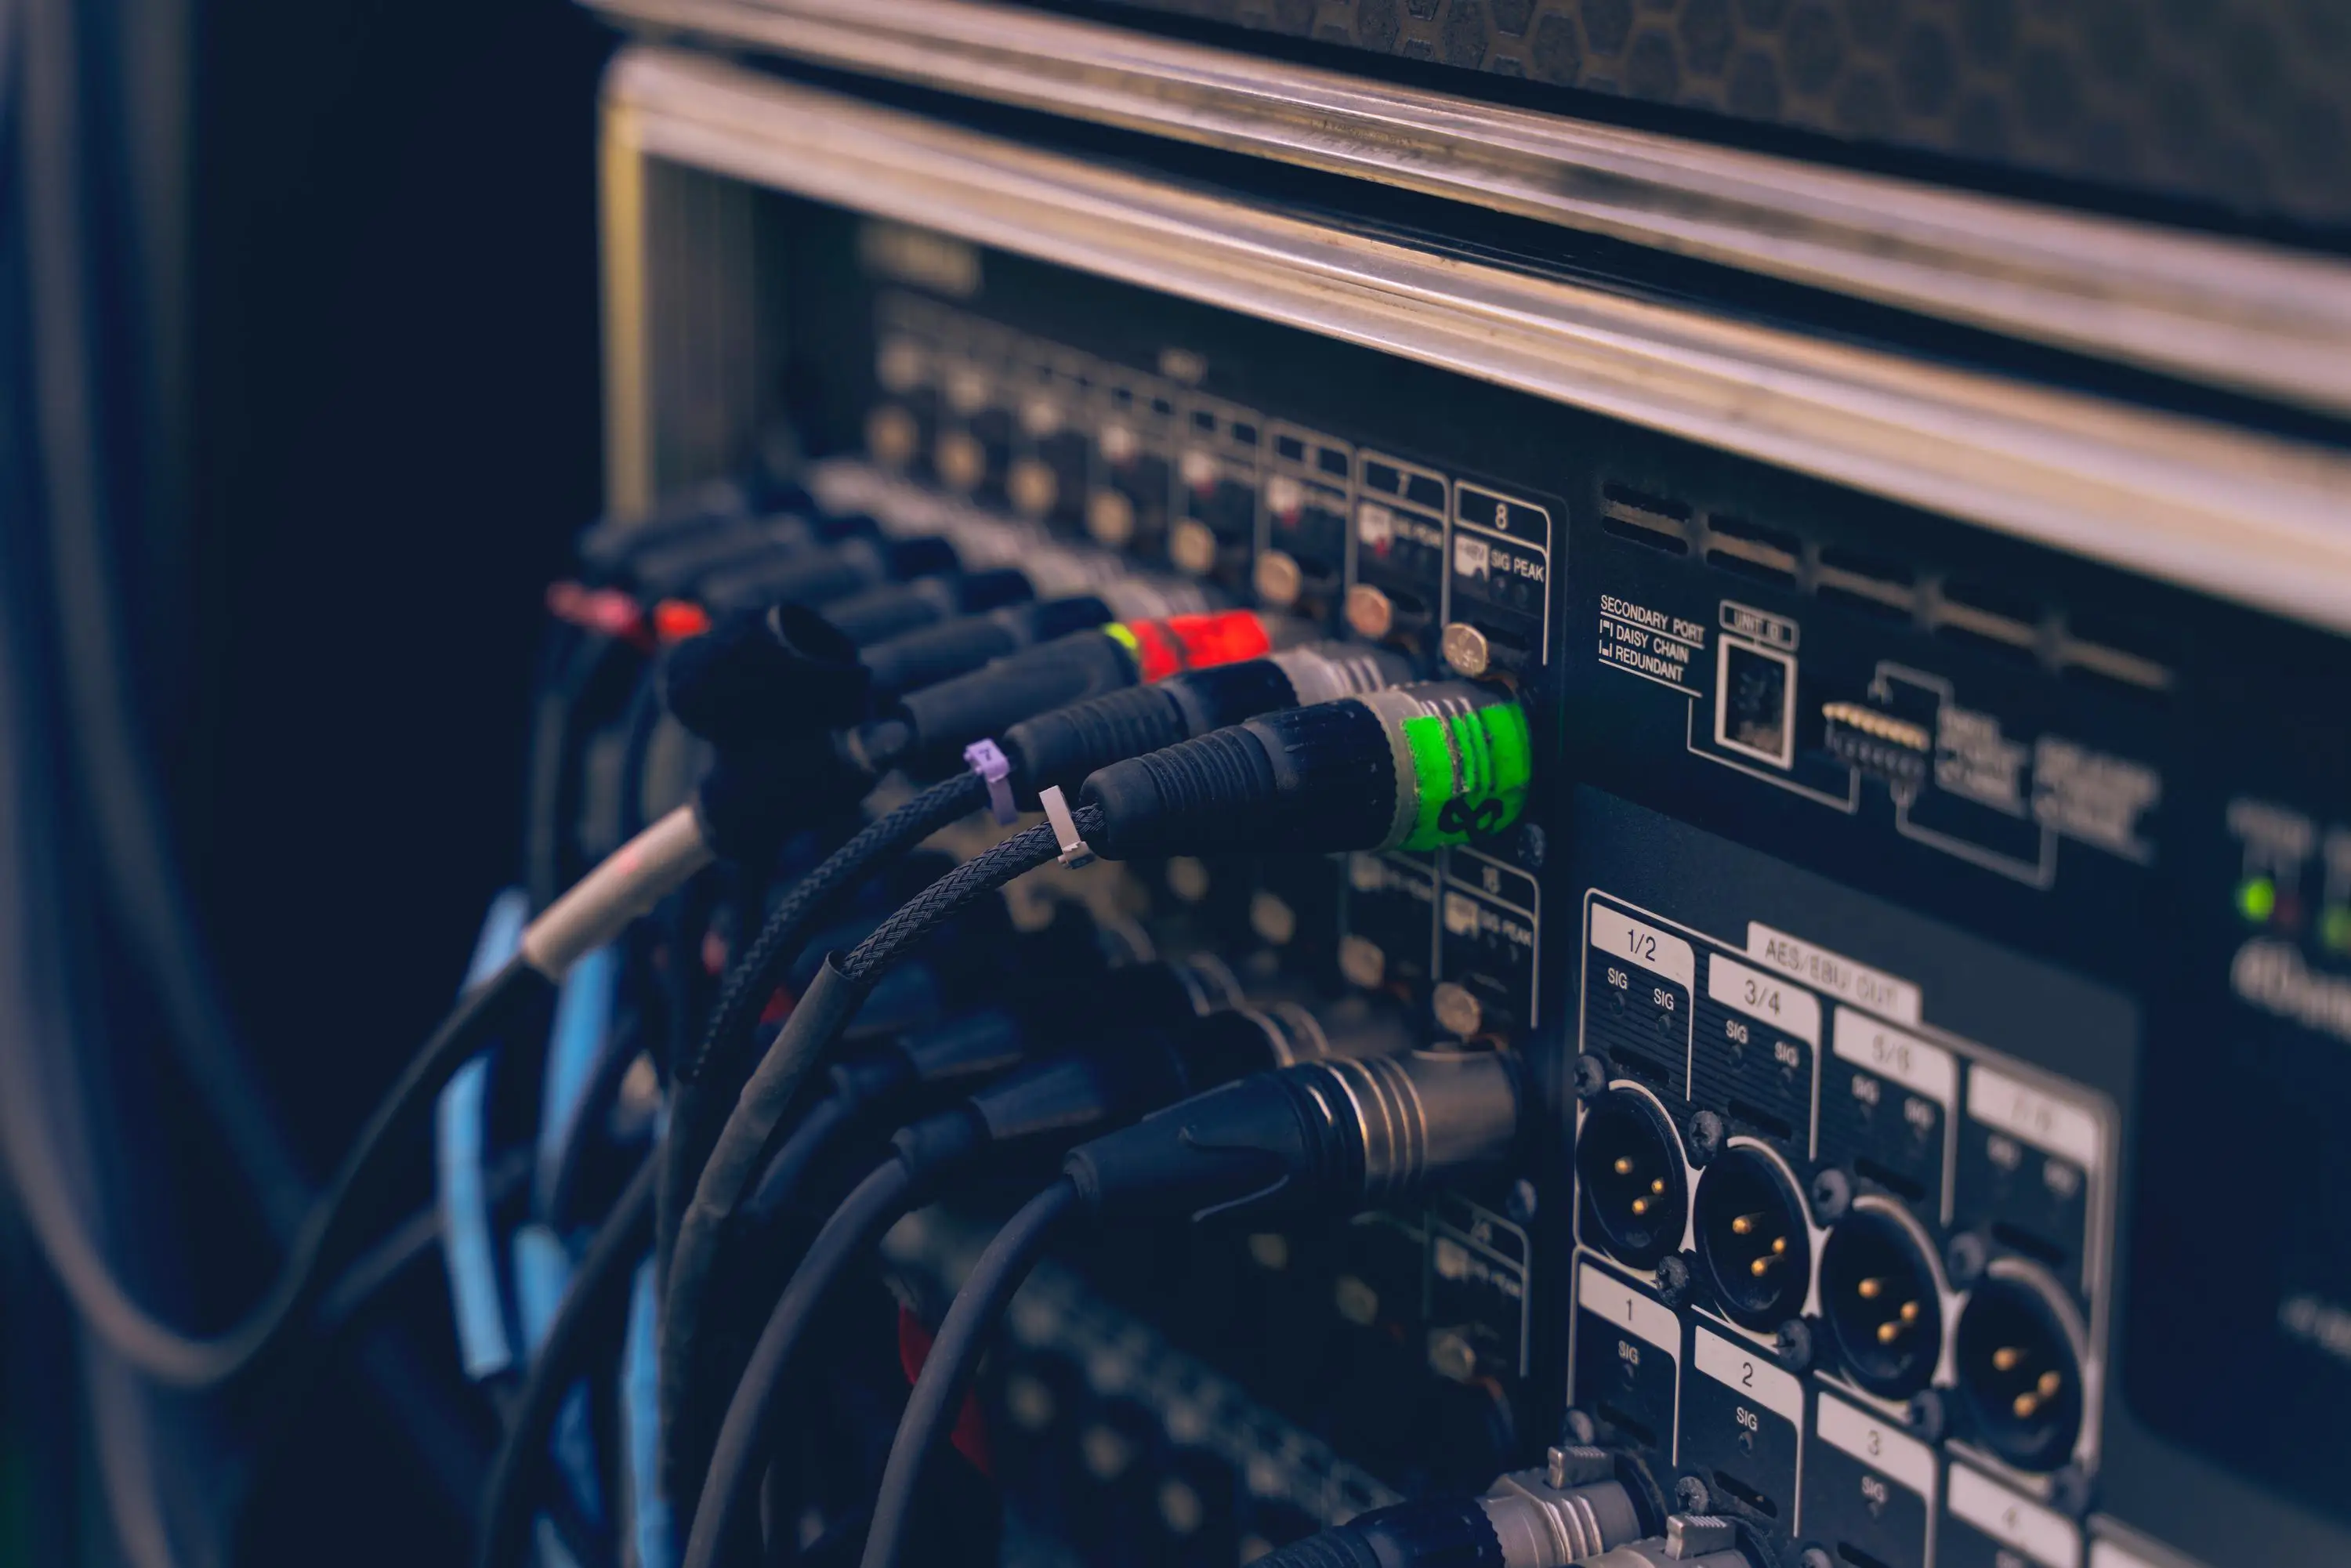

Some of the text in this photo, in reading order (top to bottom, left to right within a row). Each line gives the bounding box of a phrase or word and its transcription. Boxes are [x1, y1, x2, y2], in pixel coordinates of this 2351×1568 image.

[1495, 502, 1508, 531] 8
[1491, 549, 1511, 571] SIG
[1513, 556, 1544, 582] PEAK
[1600, 595, 1705, 643] SECONDARY PORT
[1616, 625, 1690, 664] DAISY CHAIN
[1615, 645, 1683, 682] REDUNDANT
[1627, 928, 1657, 962] 1/2
[1607, 967, 1628, 990] SIG
[1765, 937, 1852, 993] AES/EBU
[1653, 987, 1675, 1011] SIG
[1744, 979, 1781, 1016] 3/4
[1726, 1019, 1748, 1045] SIG
[1774, 1040, 1799, 1067] SIG
[1625, 1298, 1633, 1321] 1
[1618, 1339, 1641, 1365] SIG
[1741, 1361, 1754, 1389] 2
[1735, 1406, 1759, 1432] SIG
[1867, 1429, 1881, 1457] 3
[1860, 1475, 1889, 1505] SIG
